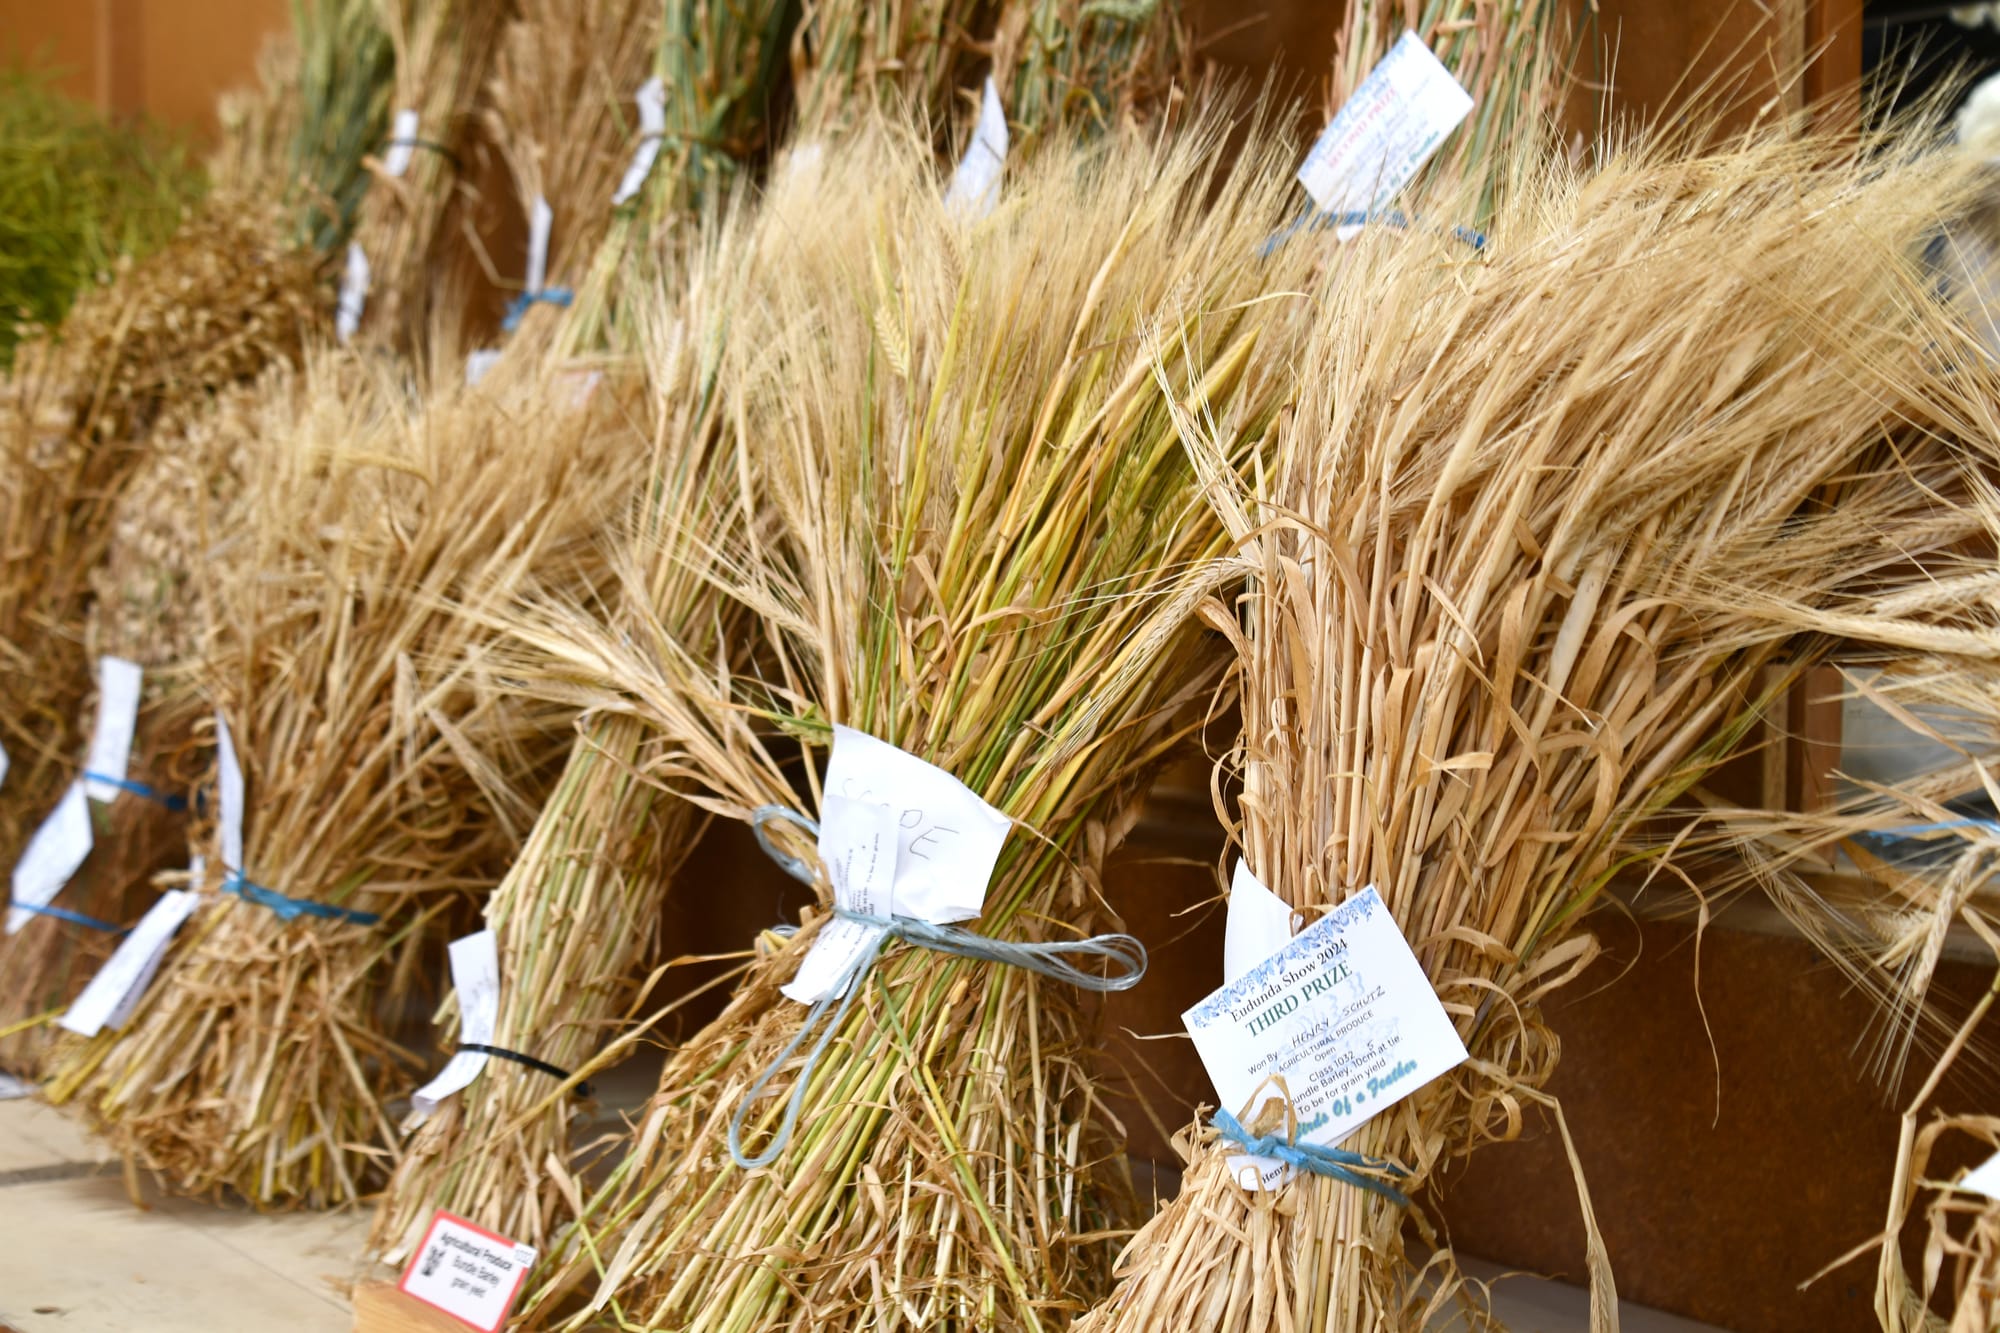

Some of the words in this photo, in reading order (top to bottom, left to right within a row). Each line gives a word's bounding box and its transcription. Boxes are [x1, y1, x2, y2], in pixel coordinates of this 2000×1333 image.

[1229, 984, 1283, 1023] Eudunda
[1282, 960, 1316, 988] Show
[1316, 938, 1348, 966] 2024
[1245, 994, 1299, 1037] THIRD
[1300, 959, 1353, 1002] PRIZE
[1278, 1035, 1335, 1073] AGRICULTURAL
[1335, 1009, 1374, 1038] PRODUCE
[1291, 1017, 1329, 1049] HENRY
[1314, 1046, 1337, 1062] Open
[1351, 1049, 1377, 1069] 10cm
[1377, 1042, 1387, 1054] at
[1247, 1059, 1267, 1075] Won
[1266, 1051, 1278, 1063] By
[1308, 1065, 1334, 1083] Class
[1333, 1050, 1356, 1069] 1032
[1297, 1104, 1311, 1116] To
[1310, 1096, 1324, 1108] be
[1324, 1087, 1339, 1100] for
[1340, 1073, 1364, 1093] grain
[1364, 1057, 1387, 1080] yield
[1332, 1095, 1353, 1118] Of
[1355, 1091, 1366, 1104] a
[1366, 1059, 1417, 1098] Feather
